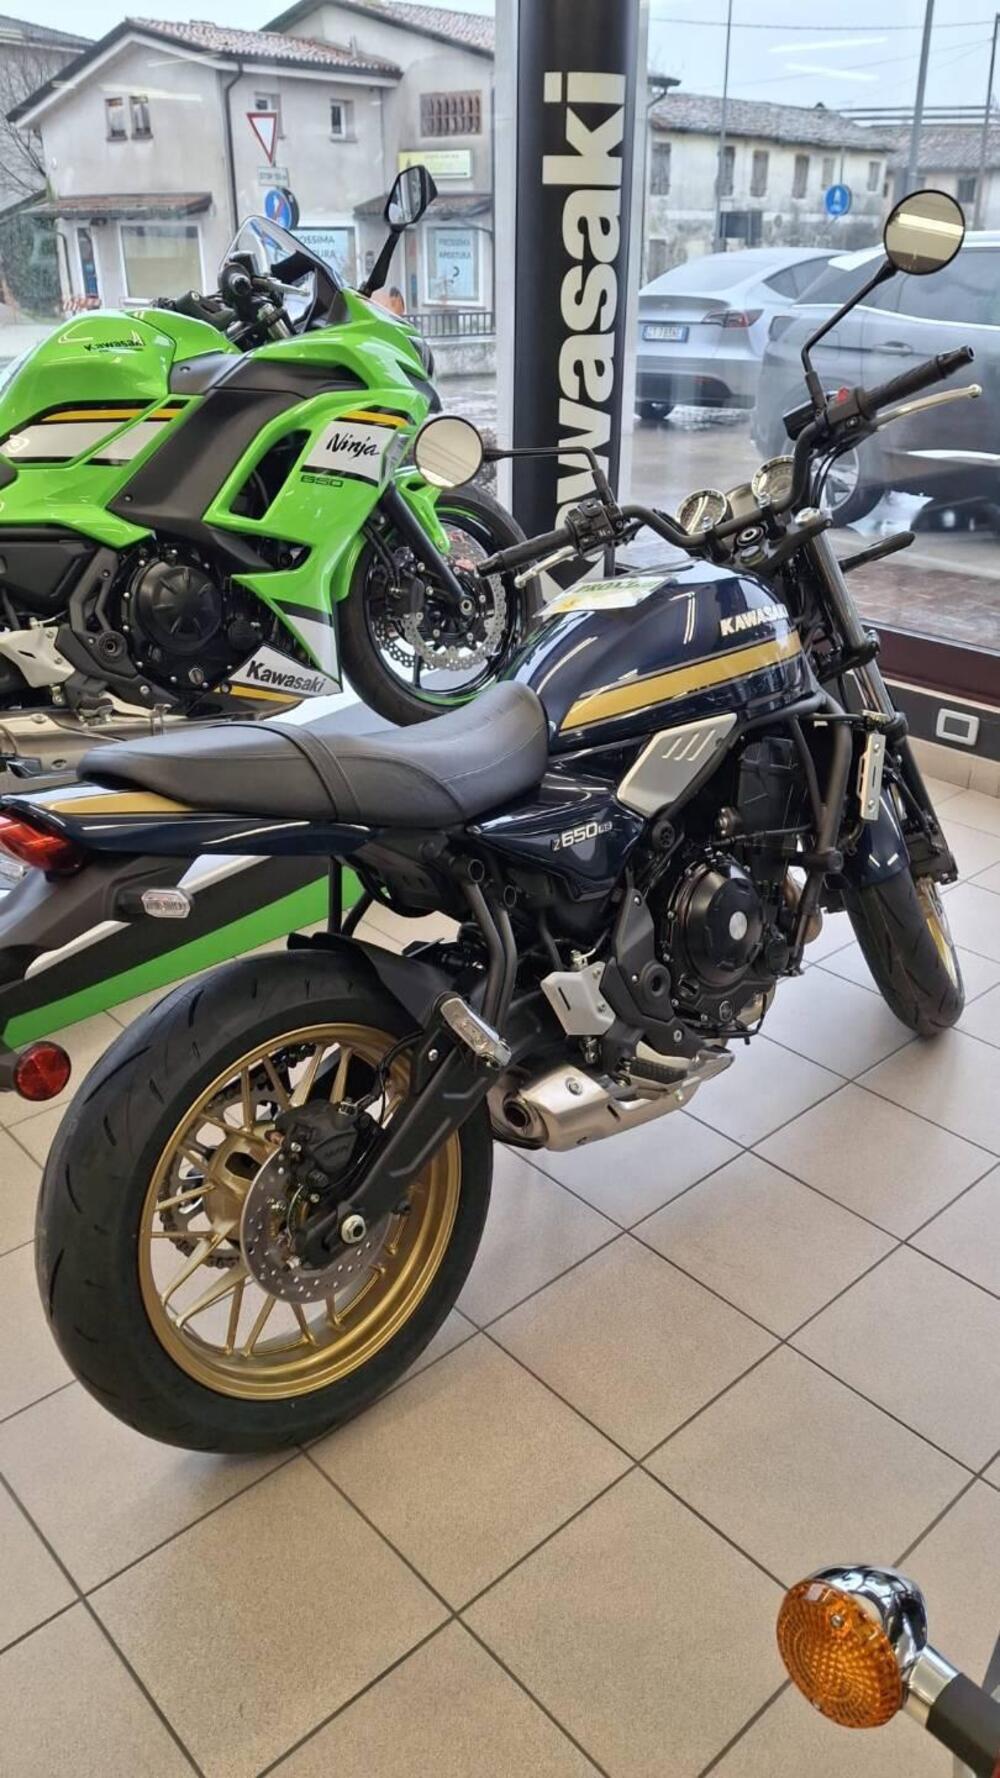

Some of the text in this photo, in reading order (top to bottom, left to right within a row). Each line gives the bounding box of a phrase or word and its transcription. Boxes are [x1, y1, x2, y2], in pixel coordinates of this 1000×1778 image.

[540, 72, 626, 604] wasaki
[325, 431, 381, 460] Ninja
[301, 474, 344, 488] 650
[246, 660, 327, 693] Kawasaki
